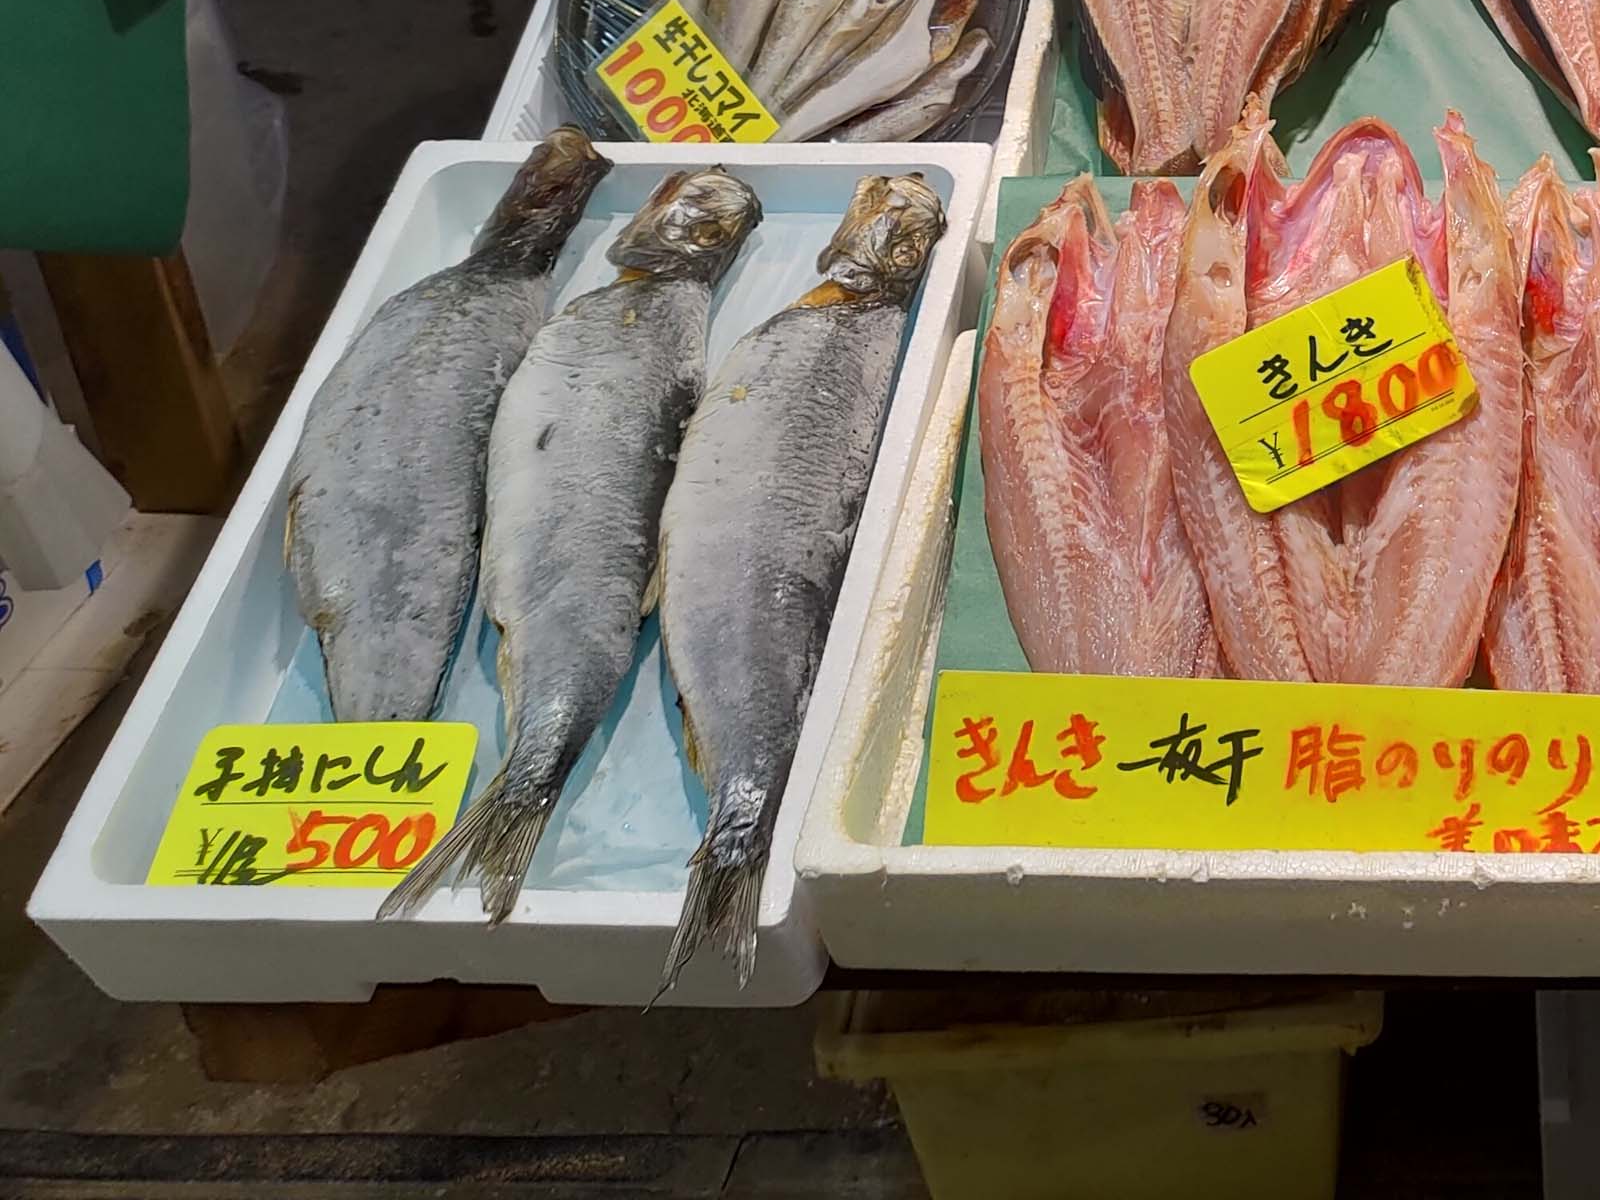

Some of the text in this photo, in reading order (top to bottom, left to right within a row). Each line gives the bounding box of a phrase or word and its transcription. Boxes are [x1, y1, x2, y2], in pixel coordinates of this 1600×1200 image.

[653, 16, 761, 134] 生干しコマイ
[1257, 316, 1394, 400] きんき
[1258, 341, 1461, 470] ¥1800
[194, 737, 449, 802] 子持にしん
[952, 712, 1108, 803] きんき
[285, 806, 437, 872] 500
